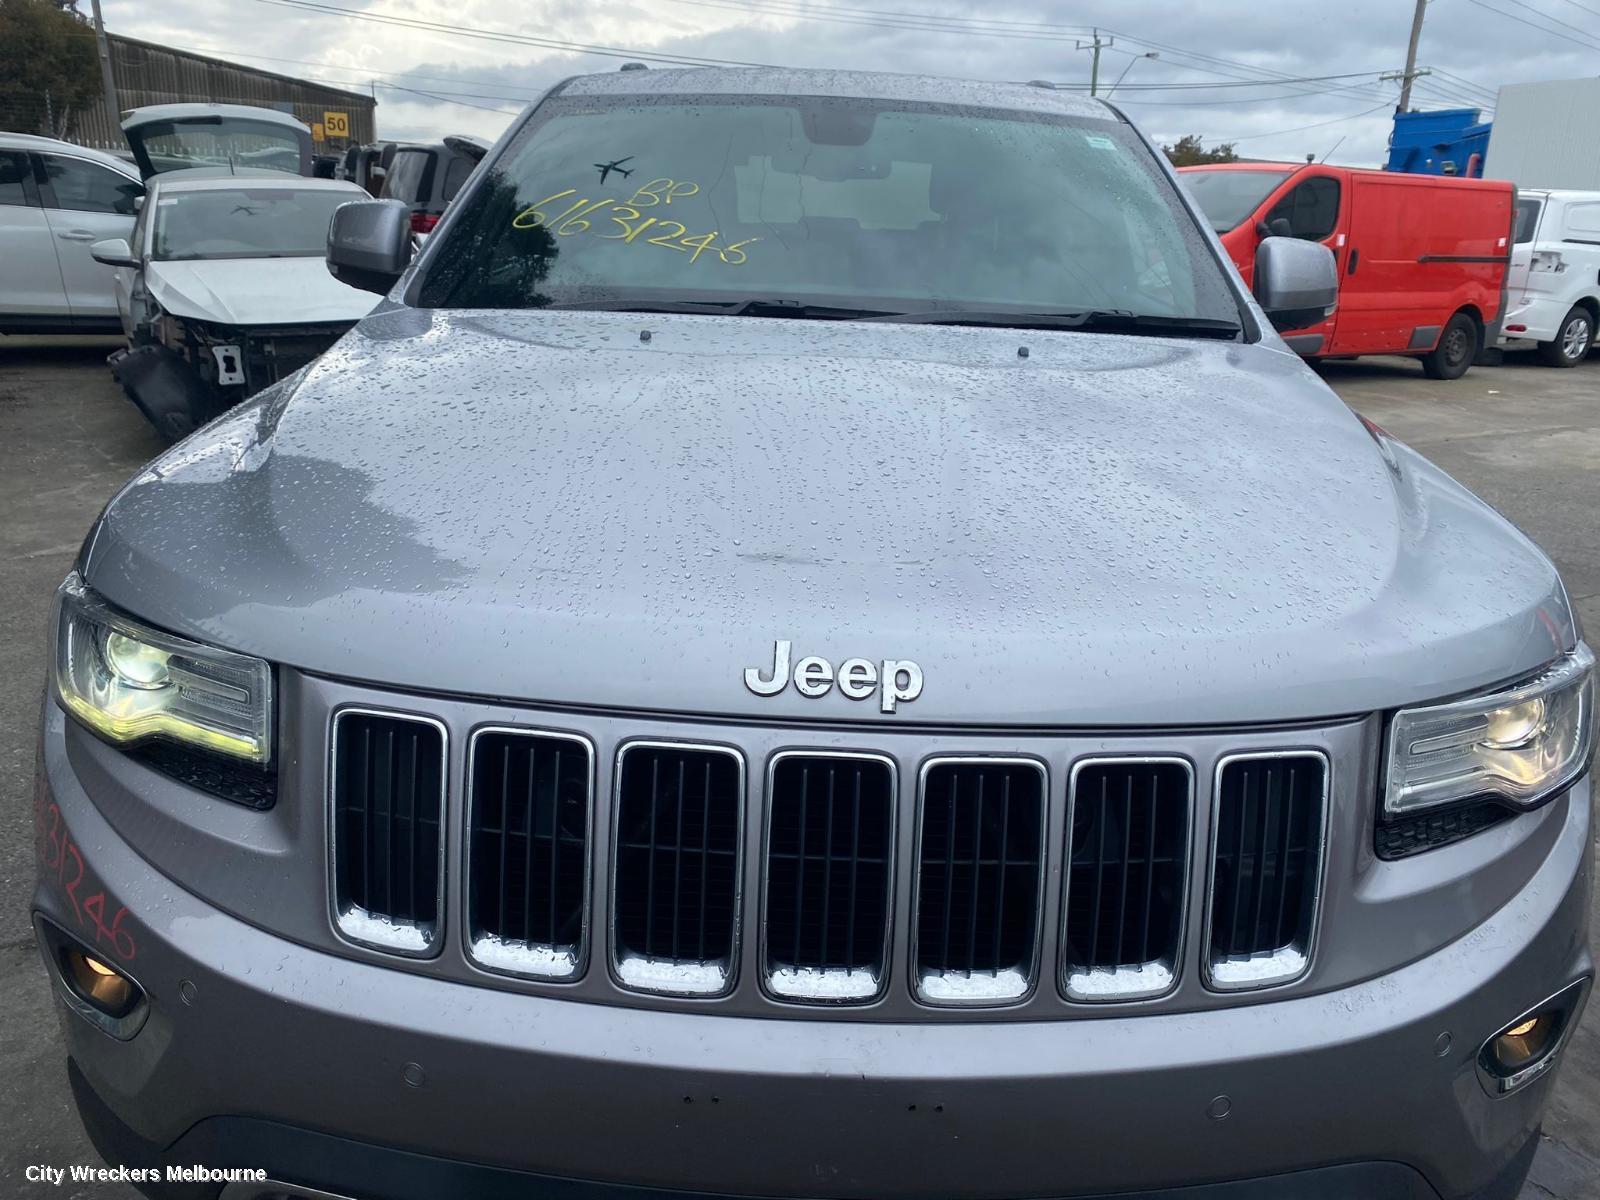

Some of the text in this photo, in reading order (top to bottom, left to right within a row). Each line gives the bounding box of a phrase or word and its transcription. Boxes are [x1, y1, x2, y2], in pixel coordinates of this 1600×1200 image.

[327, 117, 346, 132] 50
[743, 639, 924, 715] Jeep
[44, 801, 137, 961] 31246
